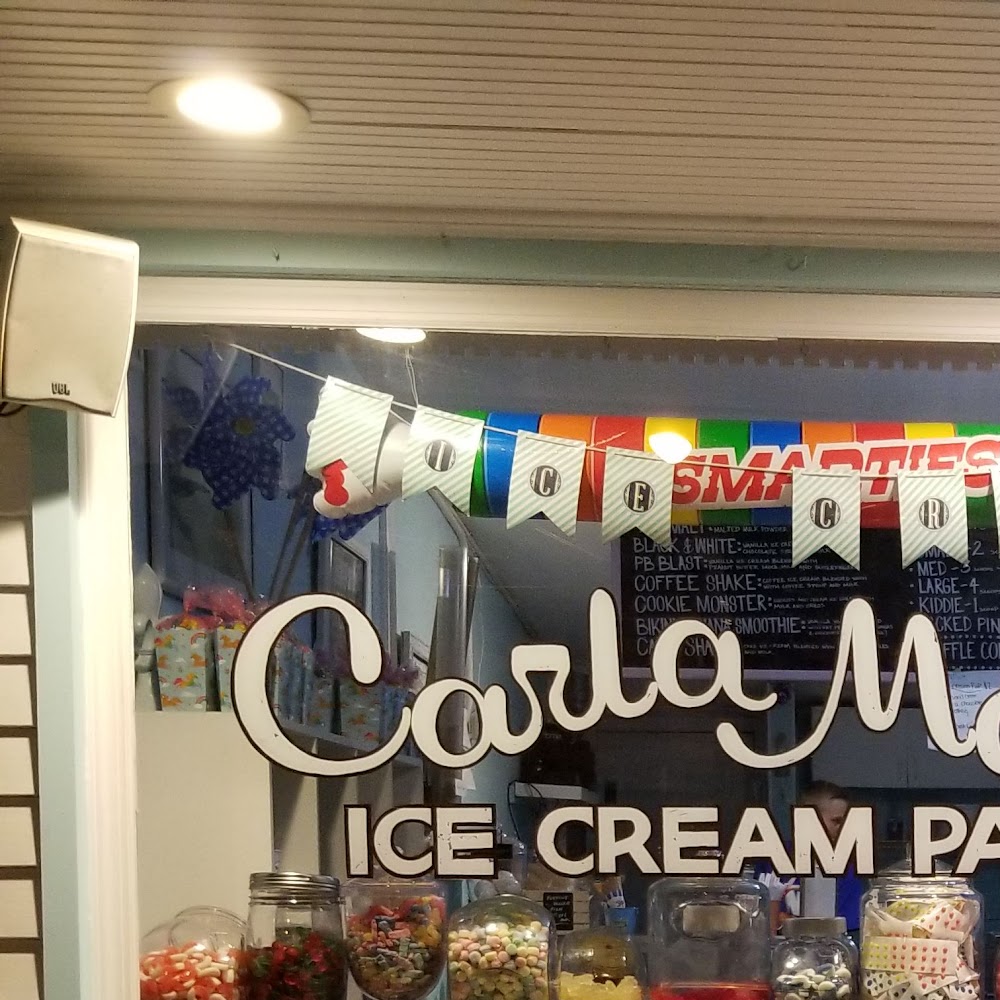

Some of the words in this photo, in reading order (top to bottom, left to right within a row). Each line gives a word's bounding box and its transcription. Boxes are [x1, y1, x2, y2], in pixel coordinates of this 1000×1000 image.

[634, 556, 654, 571] PB
[917, 560, 947, 577] MED
[634, 574, 700, 592] COFFEE
[634, 595, 692, 613] COOKIE
[231, 588, 779, 777] Carla
[343, 803, 497, 879] ICE
[535, 803, 876, 878] CREAM
